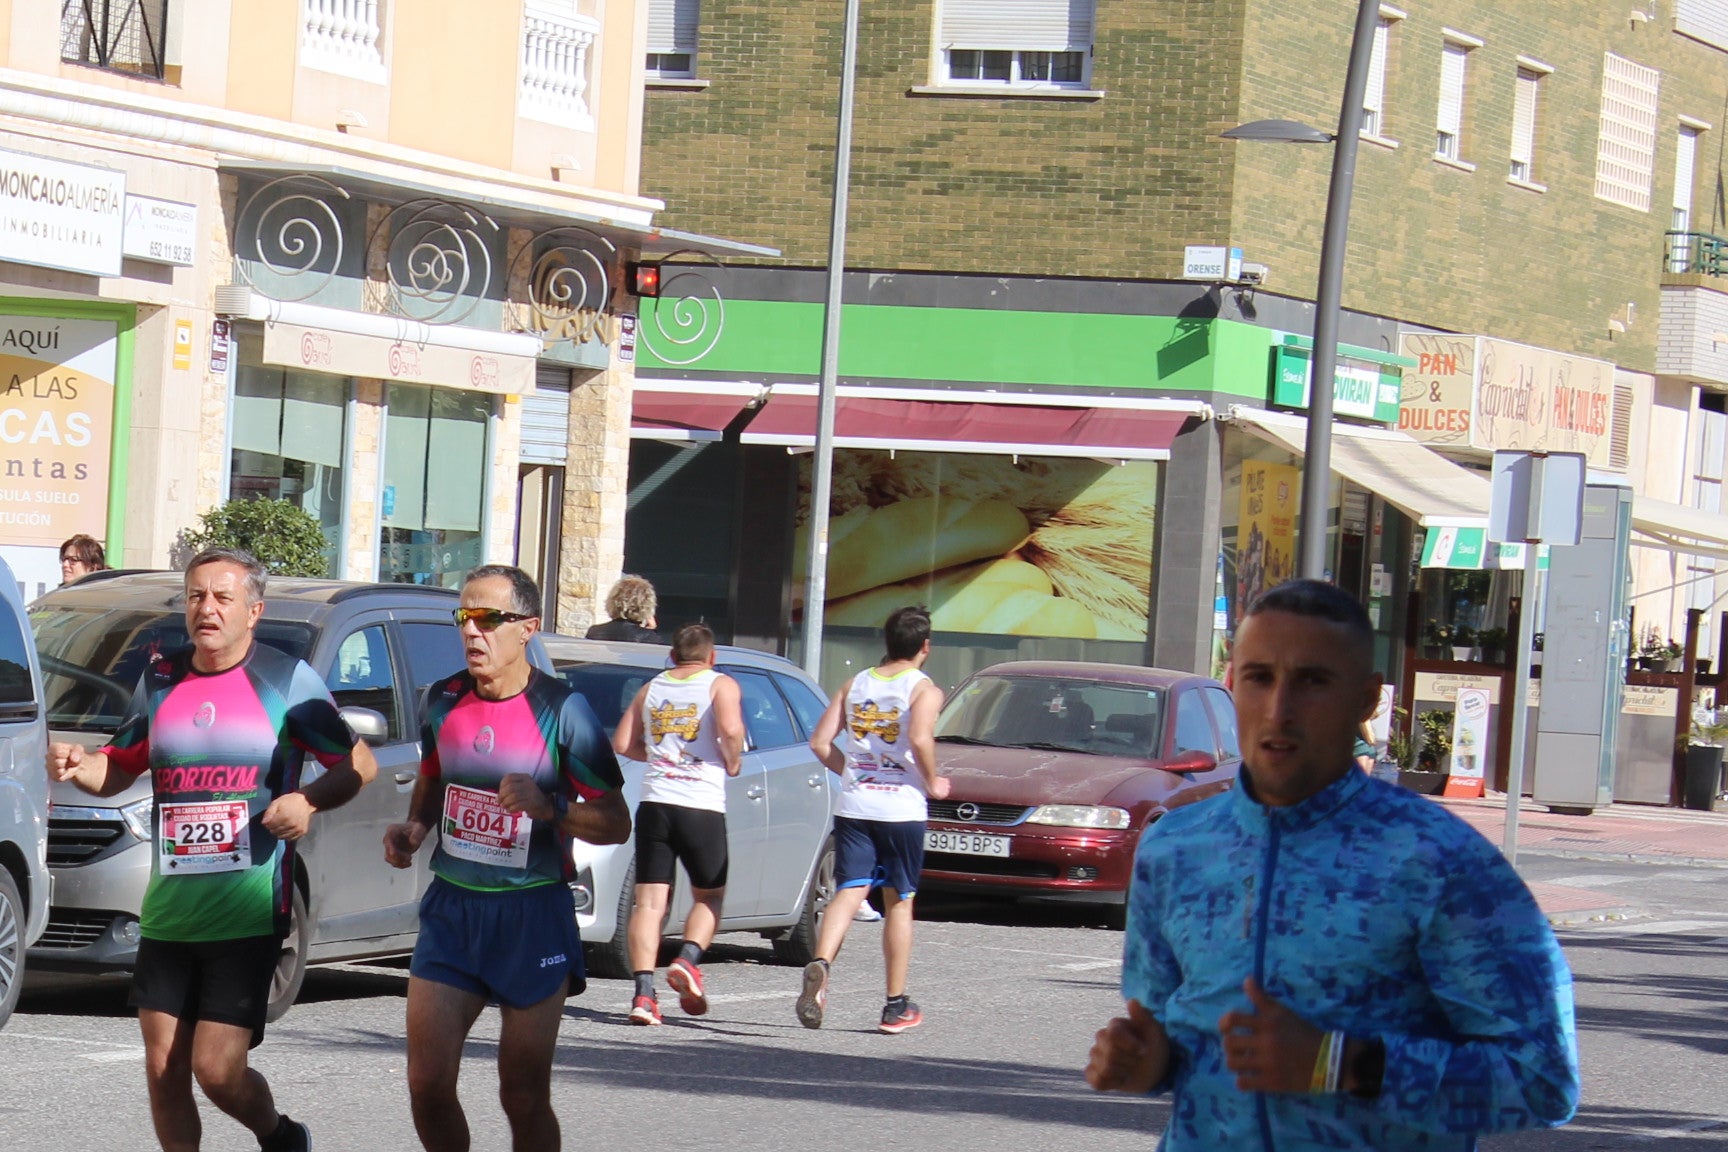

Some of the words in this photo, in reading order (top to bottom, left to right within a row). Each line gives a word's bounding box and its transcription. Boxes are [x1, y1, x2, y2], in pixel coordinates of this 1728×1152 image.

[3, 215, 102, 248] INMOBILIARIA
[1187, 264, 1221, 274] ORENSE
[2, 325, 60, 354] AQUÍ
[1419, 353, 1457, 376] PAN
[6, 374, 24, 397] A
[33, 375, 78, 400] LAS
[1333, 375, 1372, 405] OVIRAN
[1429, 380, 1442, 402] &
[1398, 407, 1470, 432] DULCES
[35, 491, 80, 505] SUELO
[155, 765, 259, 791] SPORTGYM
[181, 822, 225, 844] 228
[462, 809, 505, 835] 604
[928, 833, 968, 851] 9915
[972, 836, 1002, 853] BPS
